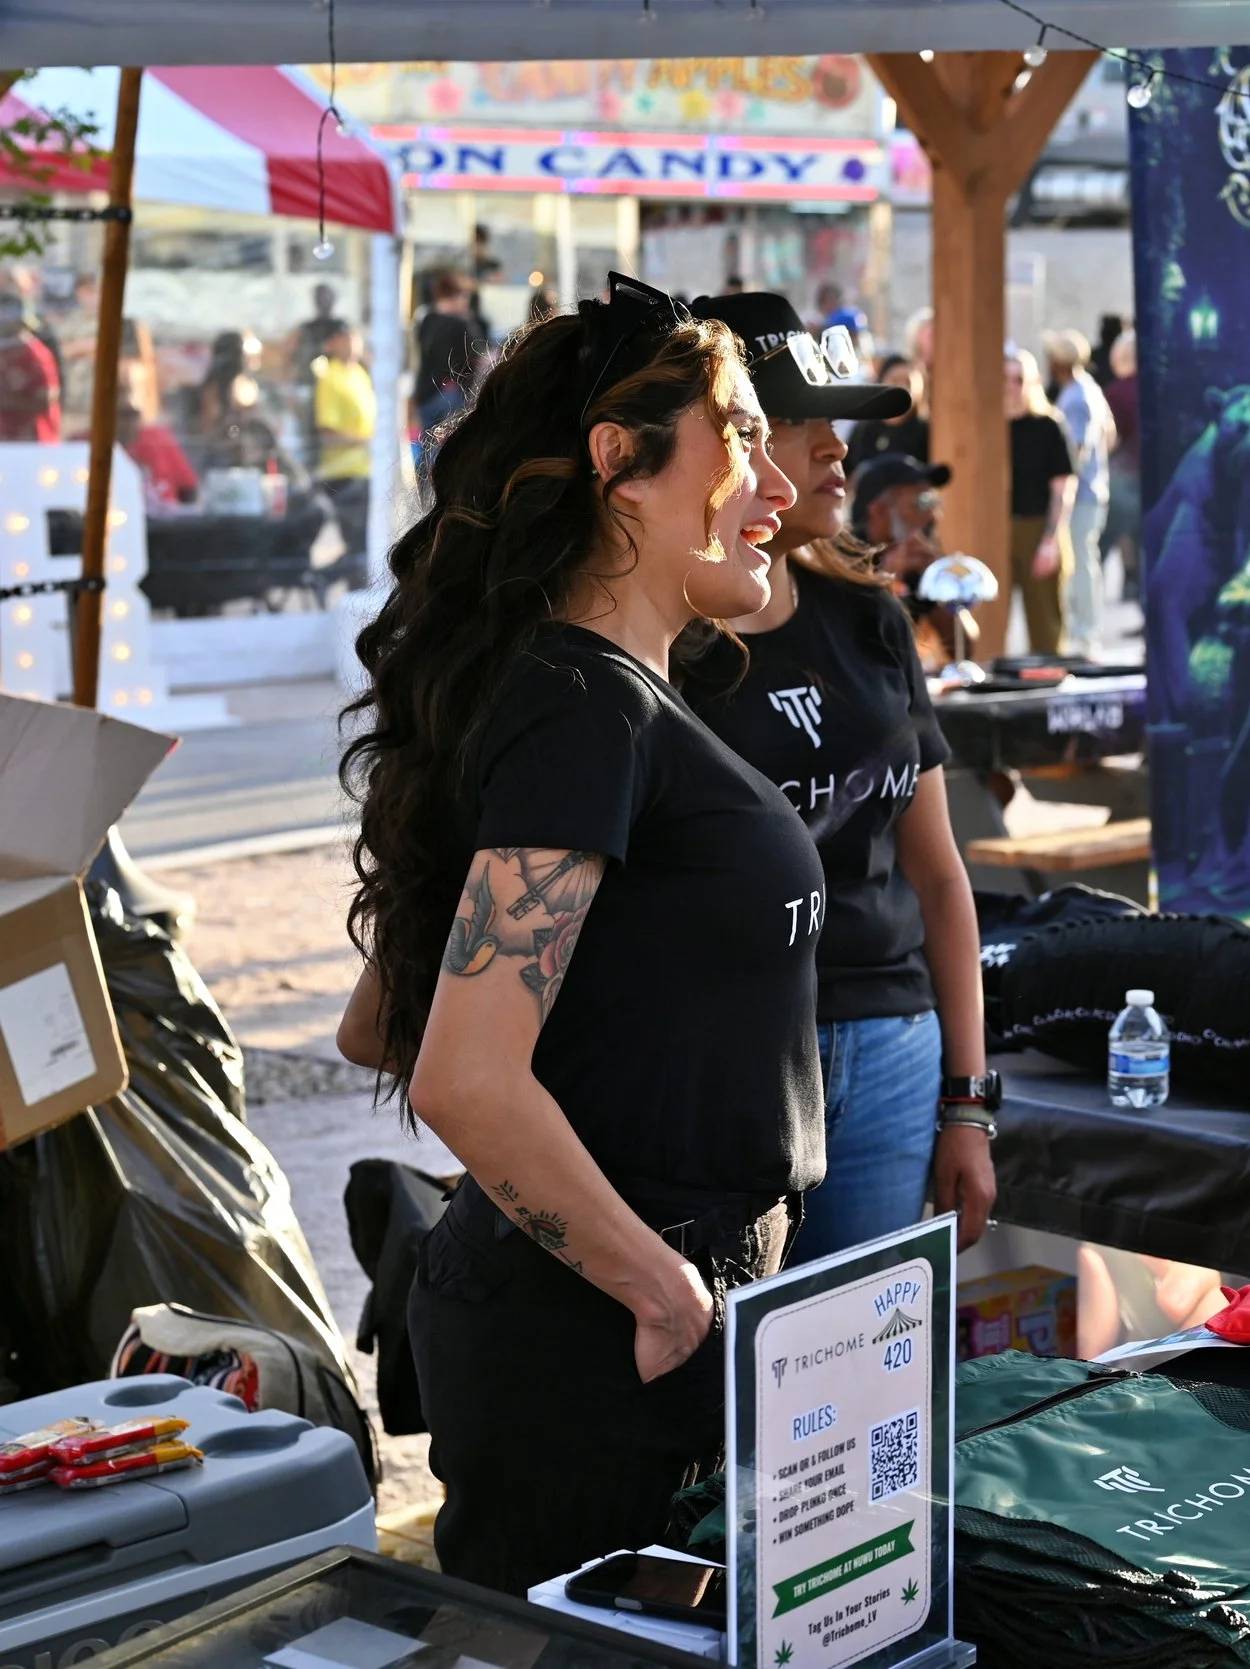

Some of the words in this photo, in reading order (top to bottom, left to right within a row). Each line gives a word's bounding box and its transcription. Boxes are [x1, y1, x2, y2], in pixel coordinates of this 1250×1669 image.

[645, 56, 814, 103] APPLES
[540, 148, 818, 184] CANDY
[874, 1280, 922, 1318] HAPPY
[795, 1333, 865, 1374] TRICHOME
[883, 1338, 912, 1371] 420
[793, 1404, 837, 1440] RULES:
[778, 1463, 798, 1480] SCAN
[799, 1457, 810, 1472] QR
[811, 1454, 817, 1466] &
[818, 1442, 846, 1464] FOLLOW
[846, 1437, 857, 1451] US
[804, 1472, 823, 1489] YOUR
[824, 1463, 846, 1482] EMAIL
[779, 1505, 799, 1523] DROP
[801, 1492, 828, 1514] PLINKO
[828, 1483, 847, 1501] ONCE
[779, 1528, 793, 1544] WIN
[794, 1509, 835, 1537] SOMETHING
[836, 1500, 855, 1519] DOPE
[793, 1582, 807, 1598] TRY
[807, 1564, 843, 1591] TRICHOME
[843, 1560, 853, 1575] AT
[874, 1540, 896, 1560] TODAY
[808, 1622, 822, 1636] Tag
[823, 1615, 834, 1628] Us
[835, 1610, 844, 1622] In
[845, 1602, 862, 1617] Your
[864, 1588, 891, 1608] Stories
[822, 1609, 877, 1648] @Trichome_LV
